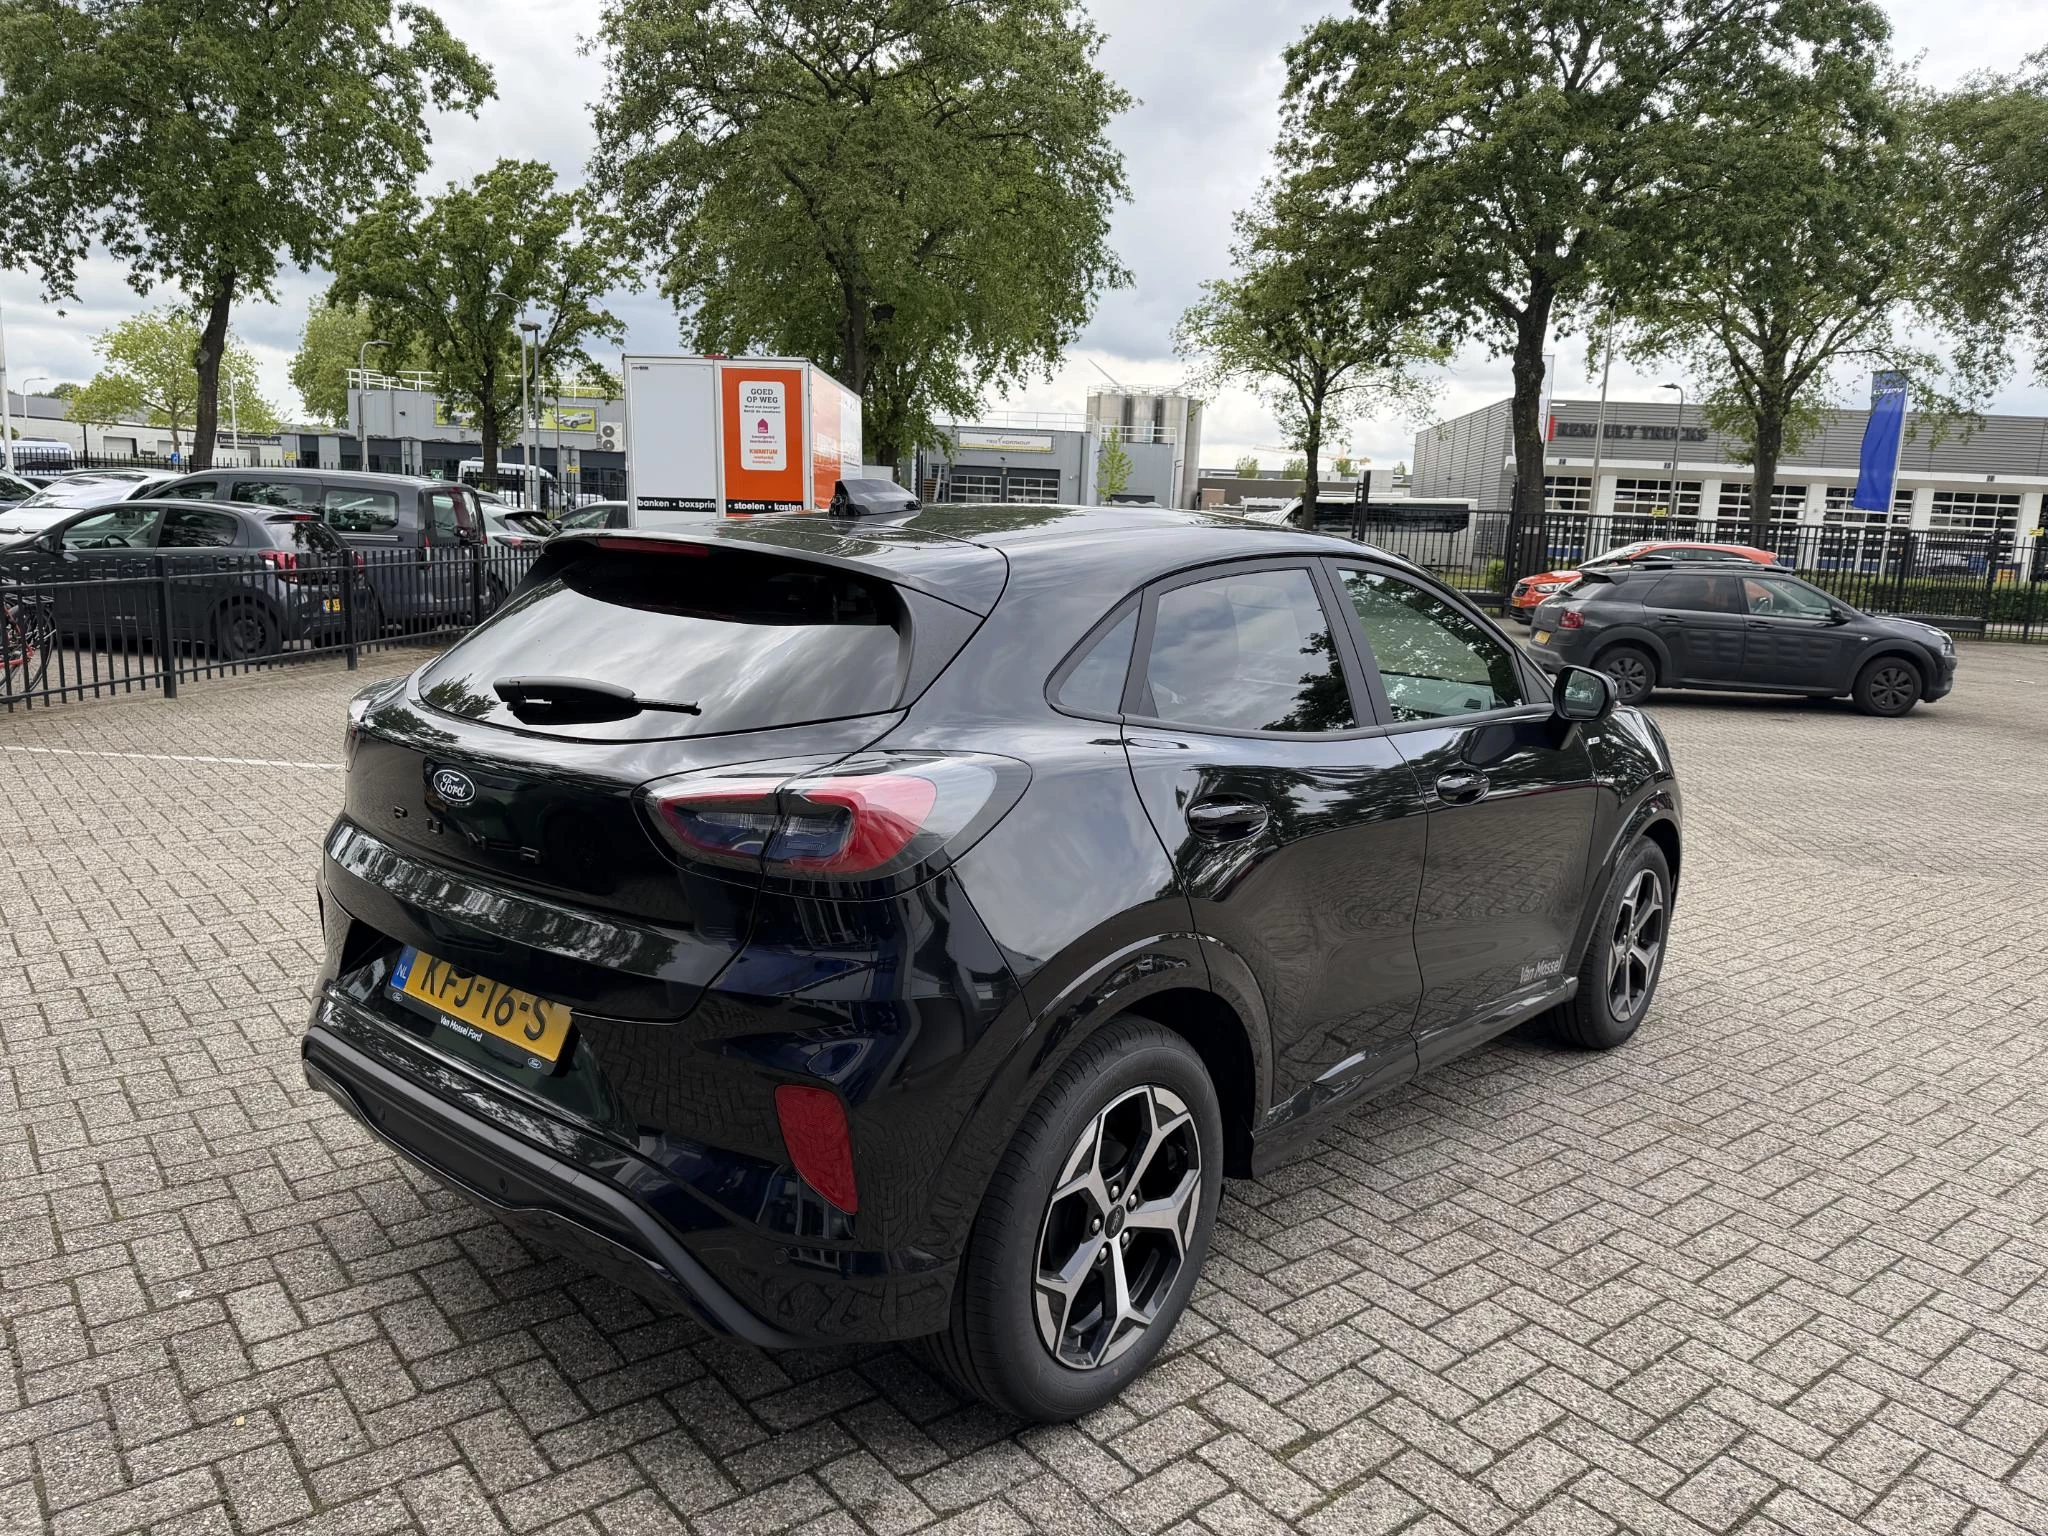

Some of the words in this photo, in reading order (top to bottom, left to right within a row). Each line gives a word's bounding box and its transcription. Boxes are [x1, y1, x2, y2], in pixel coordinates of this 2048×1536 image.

[750, 388, 774, 396] GOED
[759, 396, 778, 404] WEG
[1641, 425, 1708, 441] TRUCKS
[637, 498, 669, 507] banken
[734, 502, 765, 510] stoelen
[774, 502, 803, 512] kasten
[440, 773, 466, 798] Ford
[396, 963, 408, 979] NL
[1520, 966, 1535, 983] Van
[1534, 954, 1563, 978] Mossel
[421, 955, 555, 1041] KFJ-16-S
[440, 1014, 450, 1027] Van
[450, 1019, 470, 1036] Mossel
[468, 1028, 482, 1042] Ford
